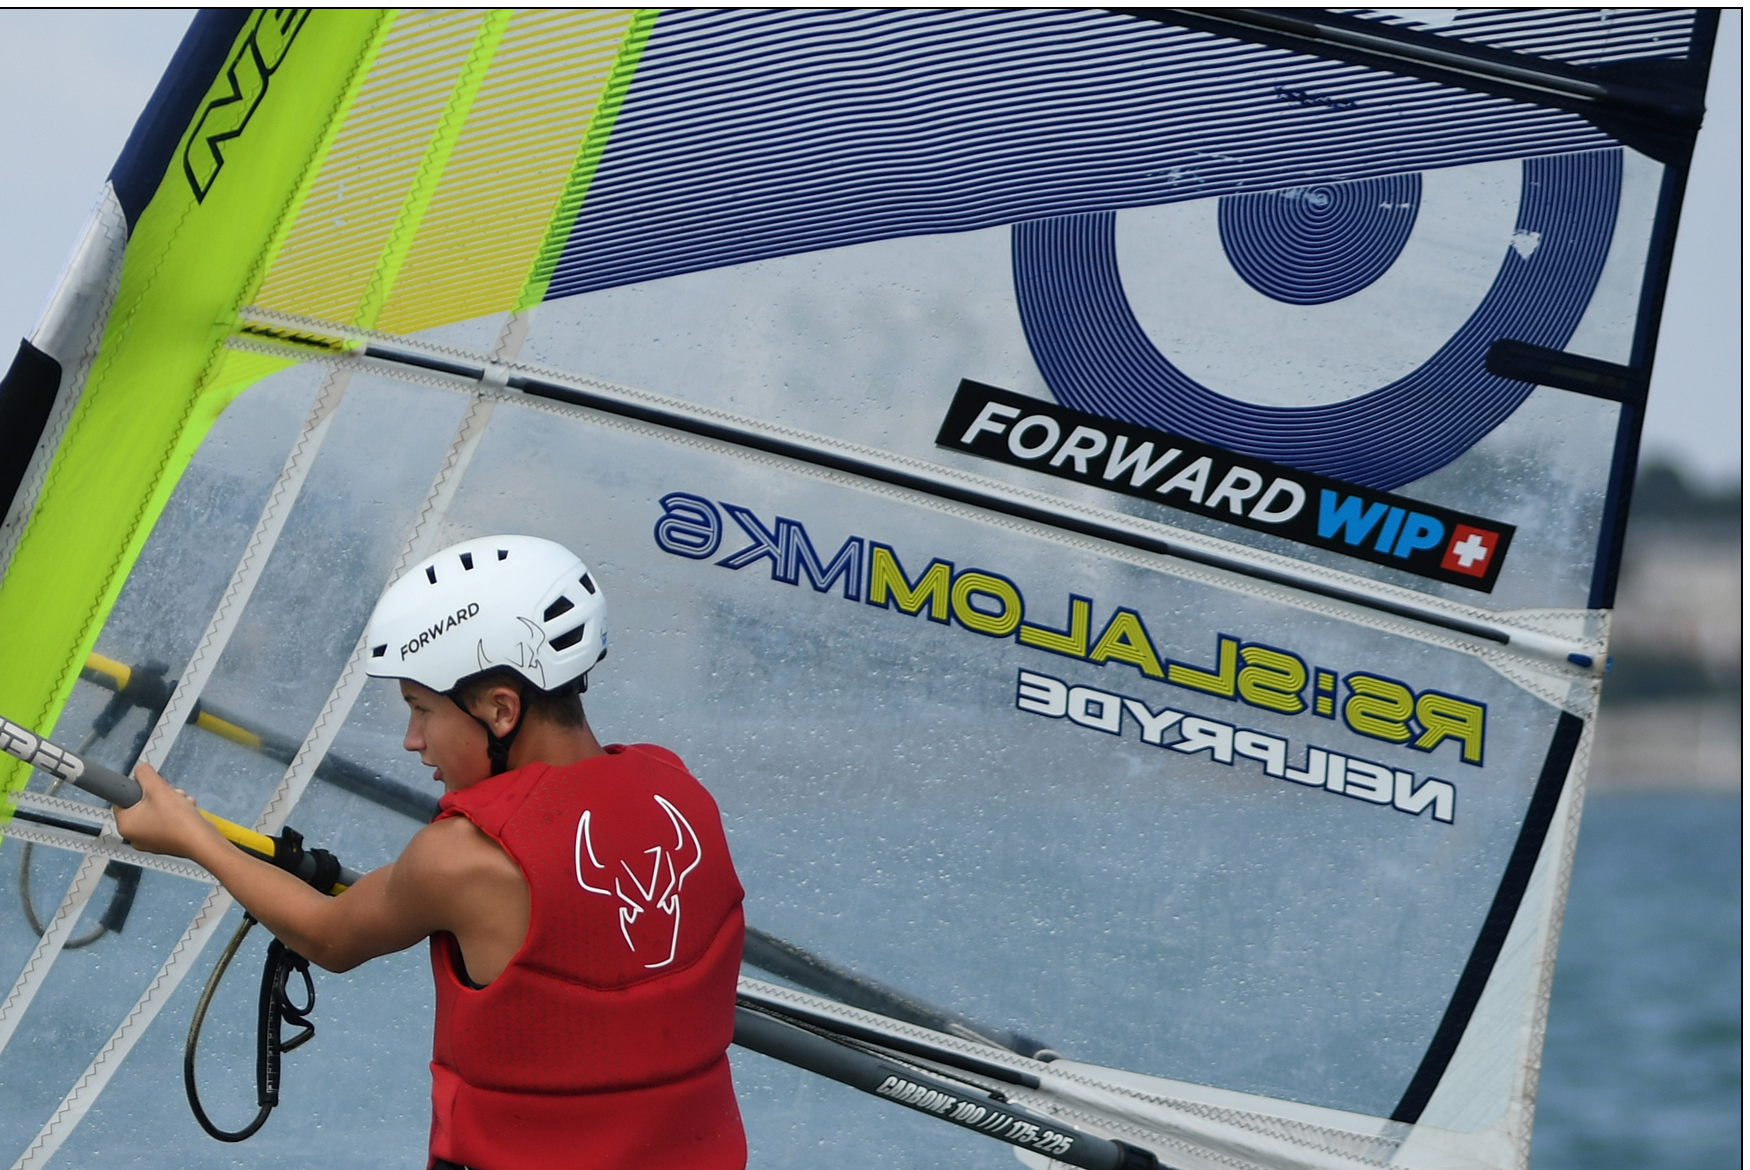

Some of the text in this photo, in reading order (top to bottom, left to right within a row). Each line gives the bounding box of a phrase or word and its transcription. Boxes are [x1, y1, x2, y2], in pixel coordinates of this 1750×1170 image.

[959, 400, 1446, 559] FORWARD WIP
[400, 602, 480, 662] FORWARD
[875, 1075, 957, 1113] CARBONE
[949, 1100, 987, 1124] 100
[1005, 1120, 1075, 1155] 175-225
